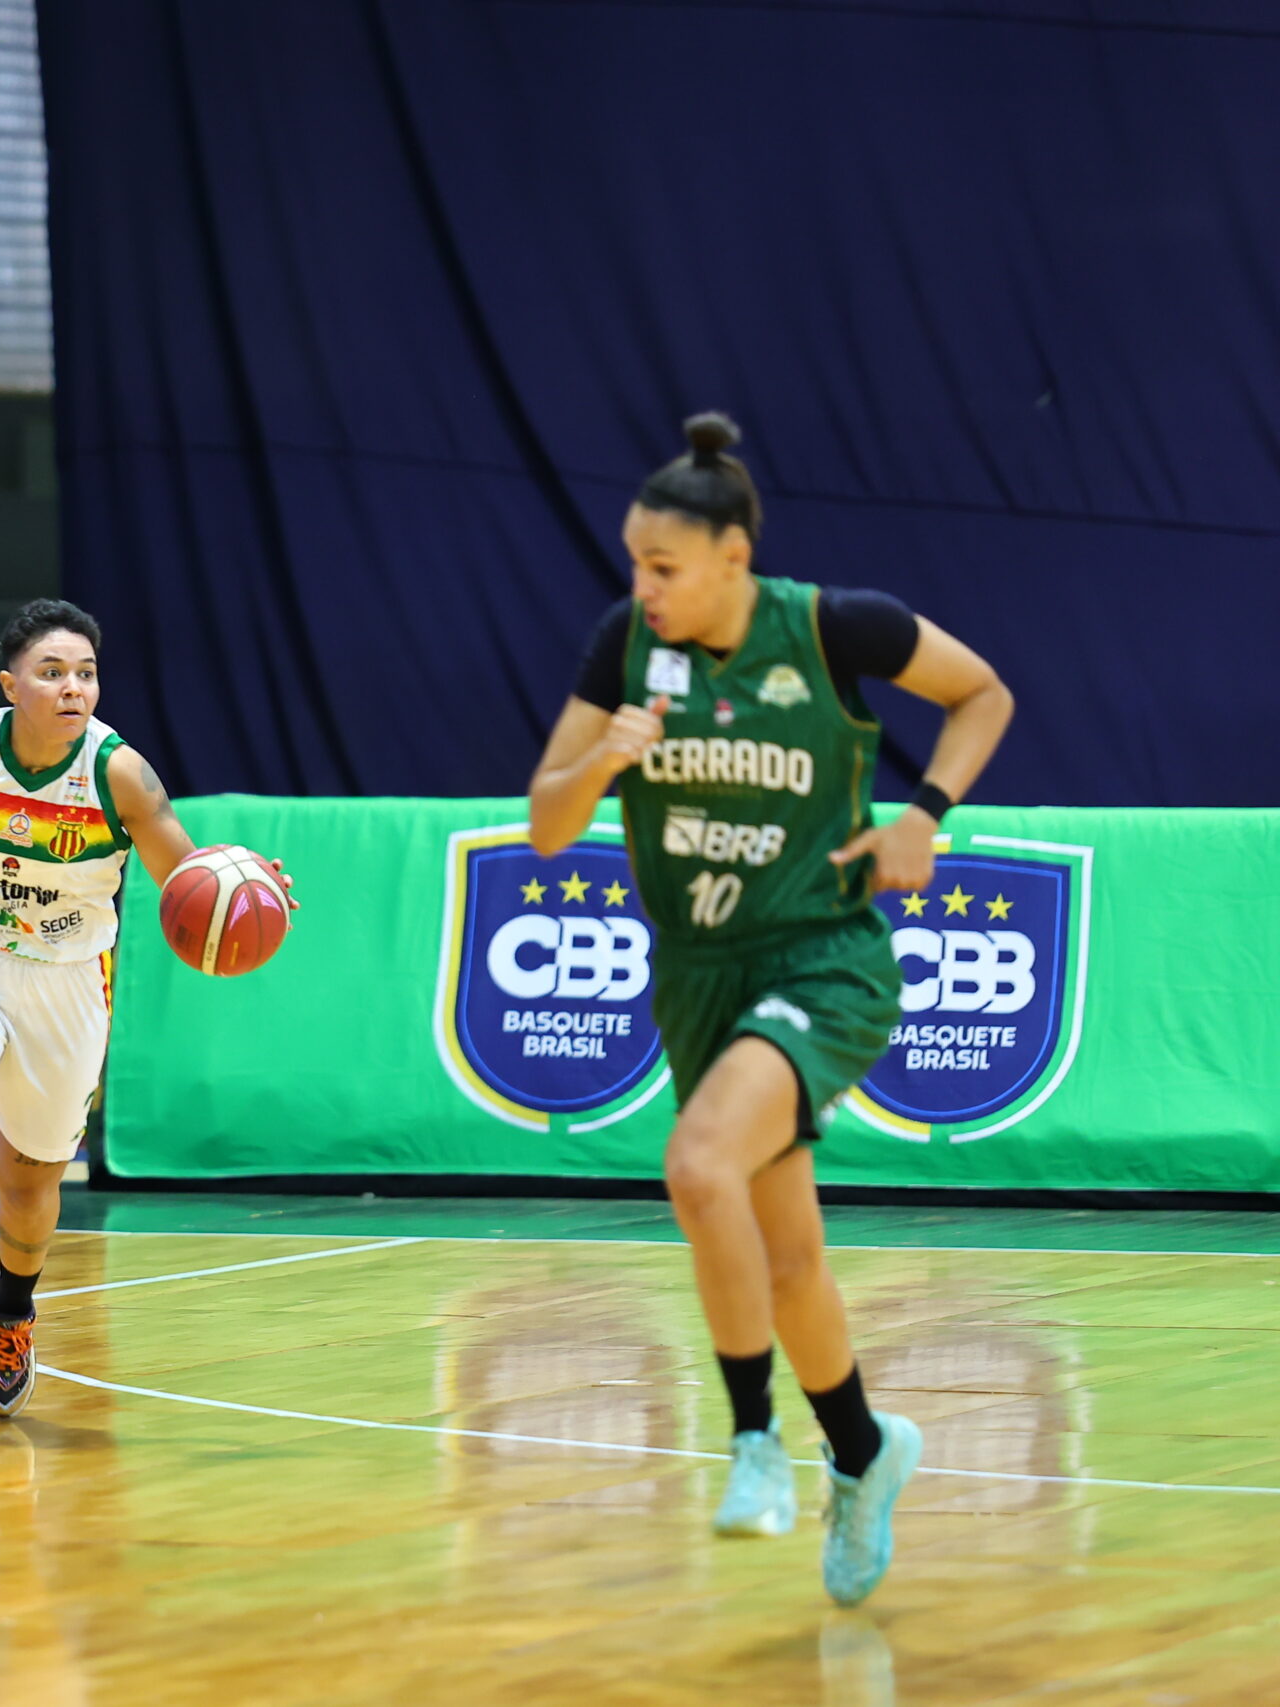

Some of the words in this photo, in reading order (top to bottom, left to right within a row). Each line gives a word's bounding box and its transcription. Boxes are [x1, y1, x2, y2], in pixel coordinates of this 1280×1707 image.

[642, 738, 814, 796] CERRADO
[704, 821, 787, 866] BRB
[687, 871, 743, 928] 10
[40, 910, 83, 933] SEDEL
[487, 914, 650, 1001] CBB
[890, 927, 1035, 1014] CBB
[502, 1010, 632, 1035] BASQUETE
[888, 1024, 1017, 1048] BASQUETE
[523, 1035, 606, 1058] BRASIL
[906, 1049, 990, 1070] BRASIL
